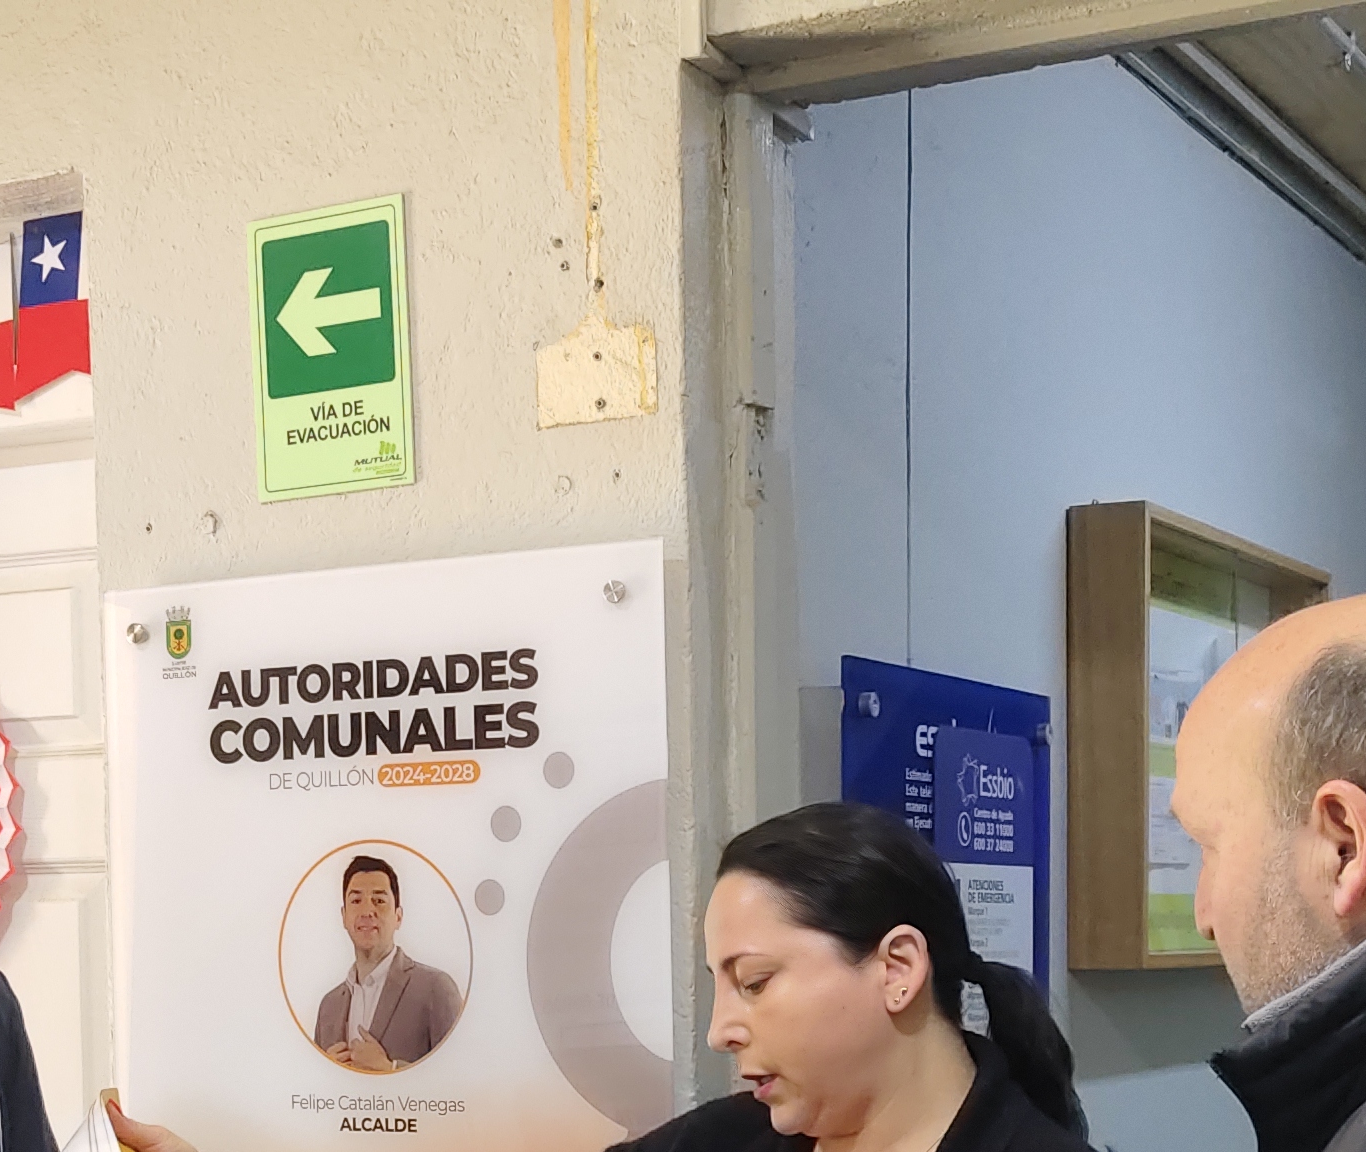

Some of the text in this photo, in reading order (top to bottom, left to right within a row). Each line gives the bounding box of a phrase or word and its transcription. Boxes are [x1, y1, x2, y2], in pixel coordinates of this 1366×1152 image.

[310, 399, 364, 422] VÍA DE
[286, 414, 391, 446] EVACUACIÓN
[354, 454, 403, 466] MUTUAL
[208, 647, 539, 709] AUTORIDADES
[209, 700, 541, 764] COMUNALES
[268, 763, 475, 792] DE QUILLÓN 2024-2028
[979, 764, 1014, 800] Essbio
[291, 1094, 466, 1115] Felipe Catalán Venegas
[339, 1117, 418, 1134] ALCALDE
